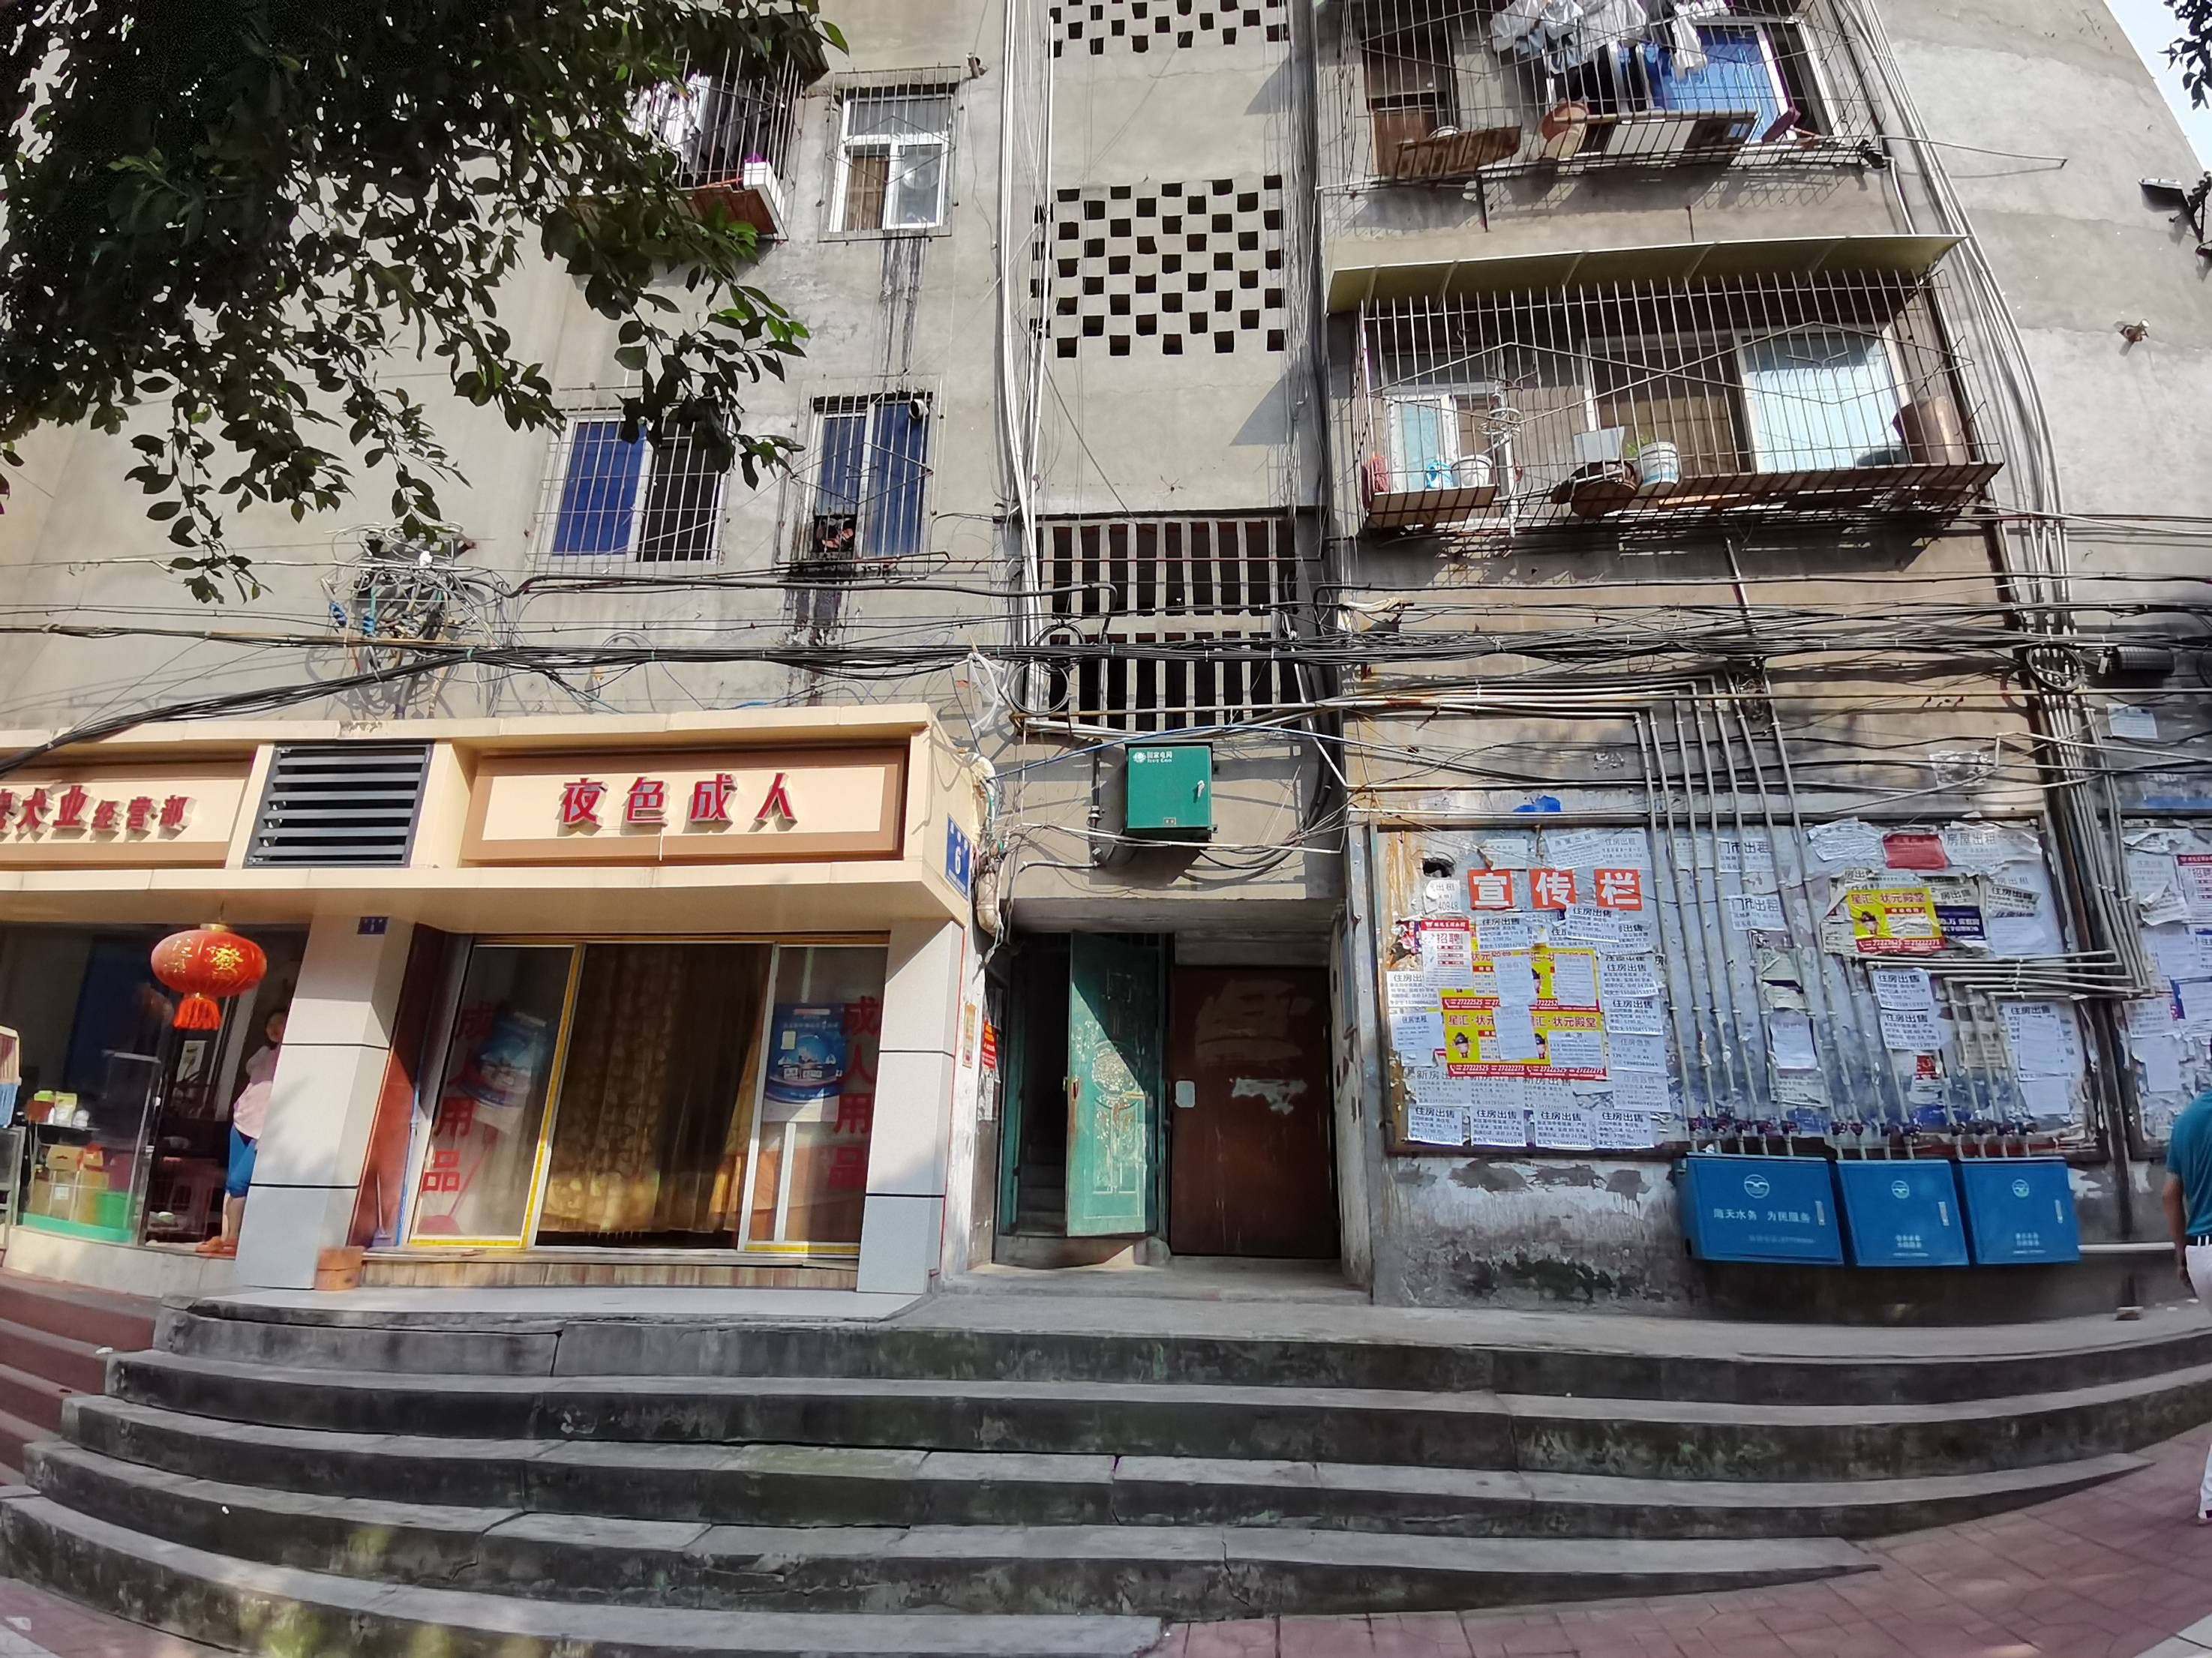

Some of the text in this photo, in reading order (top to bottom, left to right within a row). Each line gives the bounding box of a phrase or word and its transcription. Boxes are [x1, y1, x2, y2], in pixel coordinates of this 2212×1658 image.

[562, 772, 797, 826] 夜色成人
[956, 846, 961, 874] 6
[1472, 871, 1640, 907] 宣传栏
[1573, 907, 1612, 918] 住房出售
[1607, 964, 1646, 972] 住房出售
[1394, 974, 1424, 982] 住房出
[1878, 974, 1920, 983] 住房出售
[1613, 1000, 1653, 1009] 住房出售
[1886, 1014, 1928, 1023] 住房出售
[827, 995, 881, 1189] 成人用品
[1415, 1107, 1455, 1119] 住房出售
[1476, 1109, 1517, 1120] 住房出售
[1541, 1111, 1582, 1122] 住房出售
[1601, 1111, 1644, 1123] 住房出售
